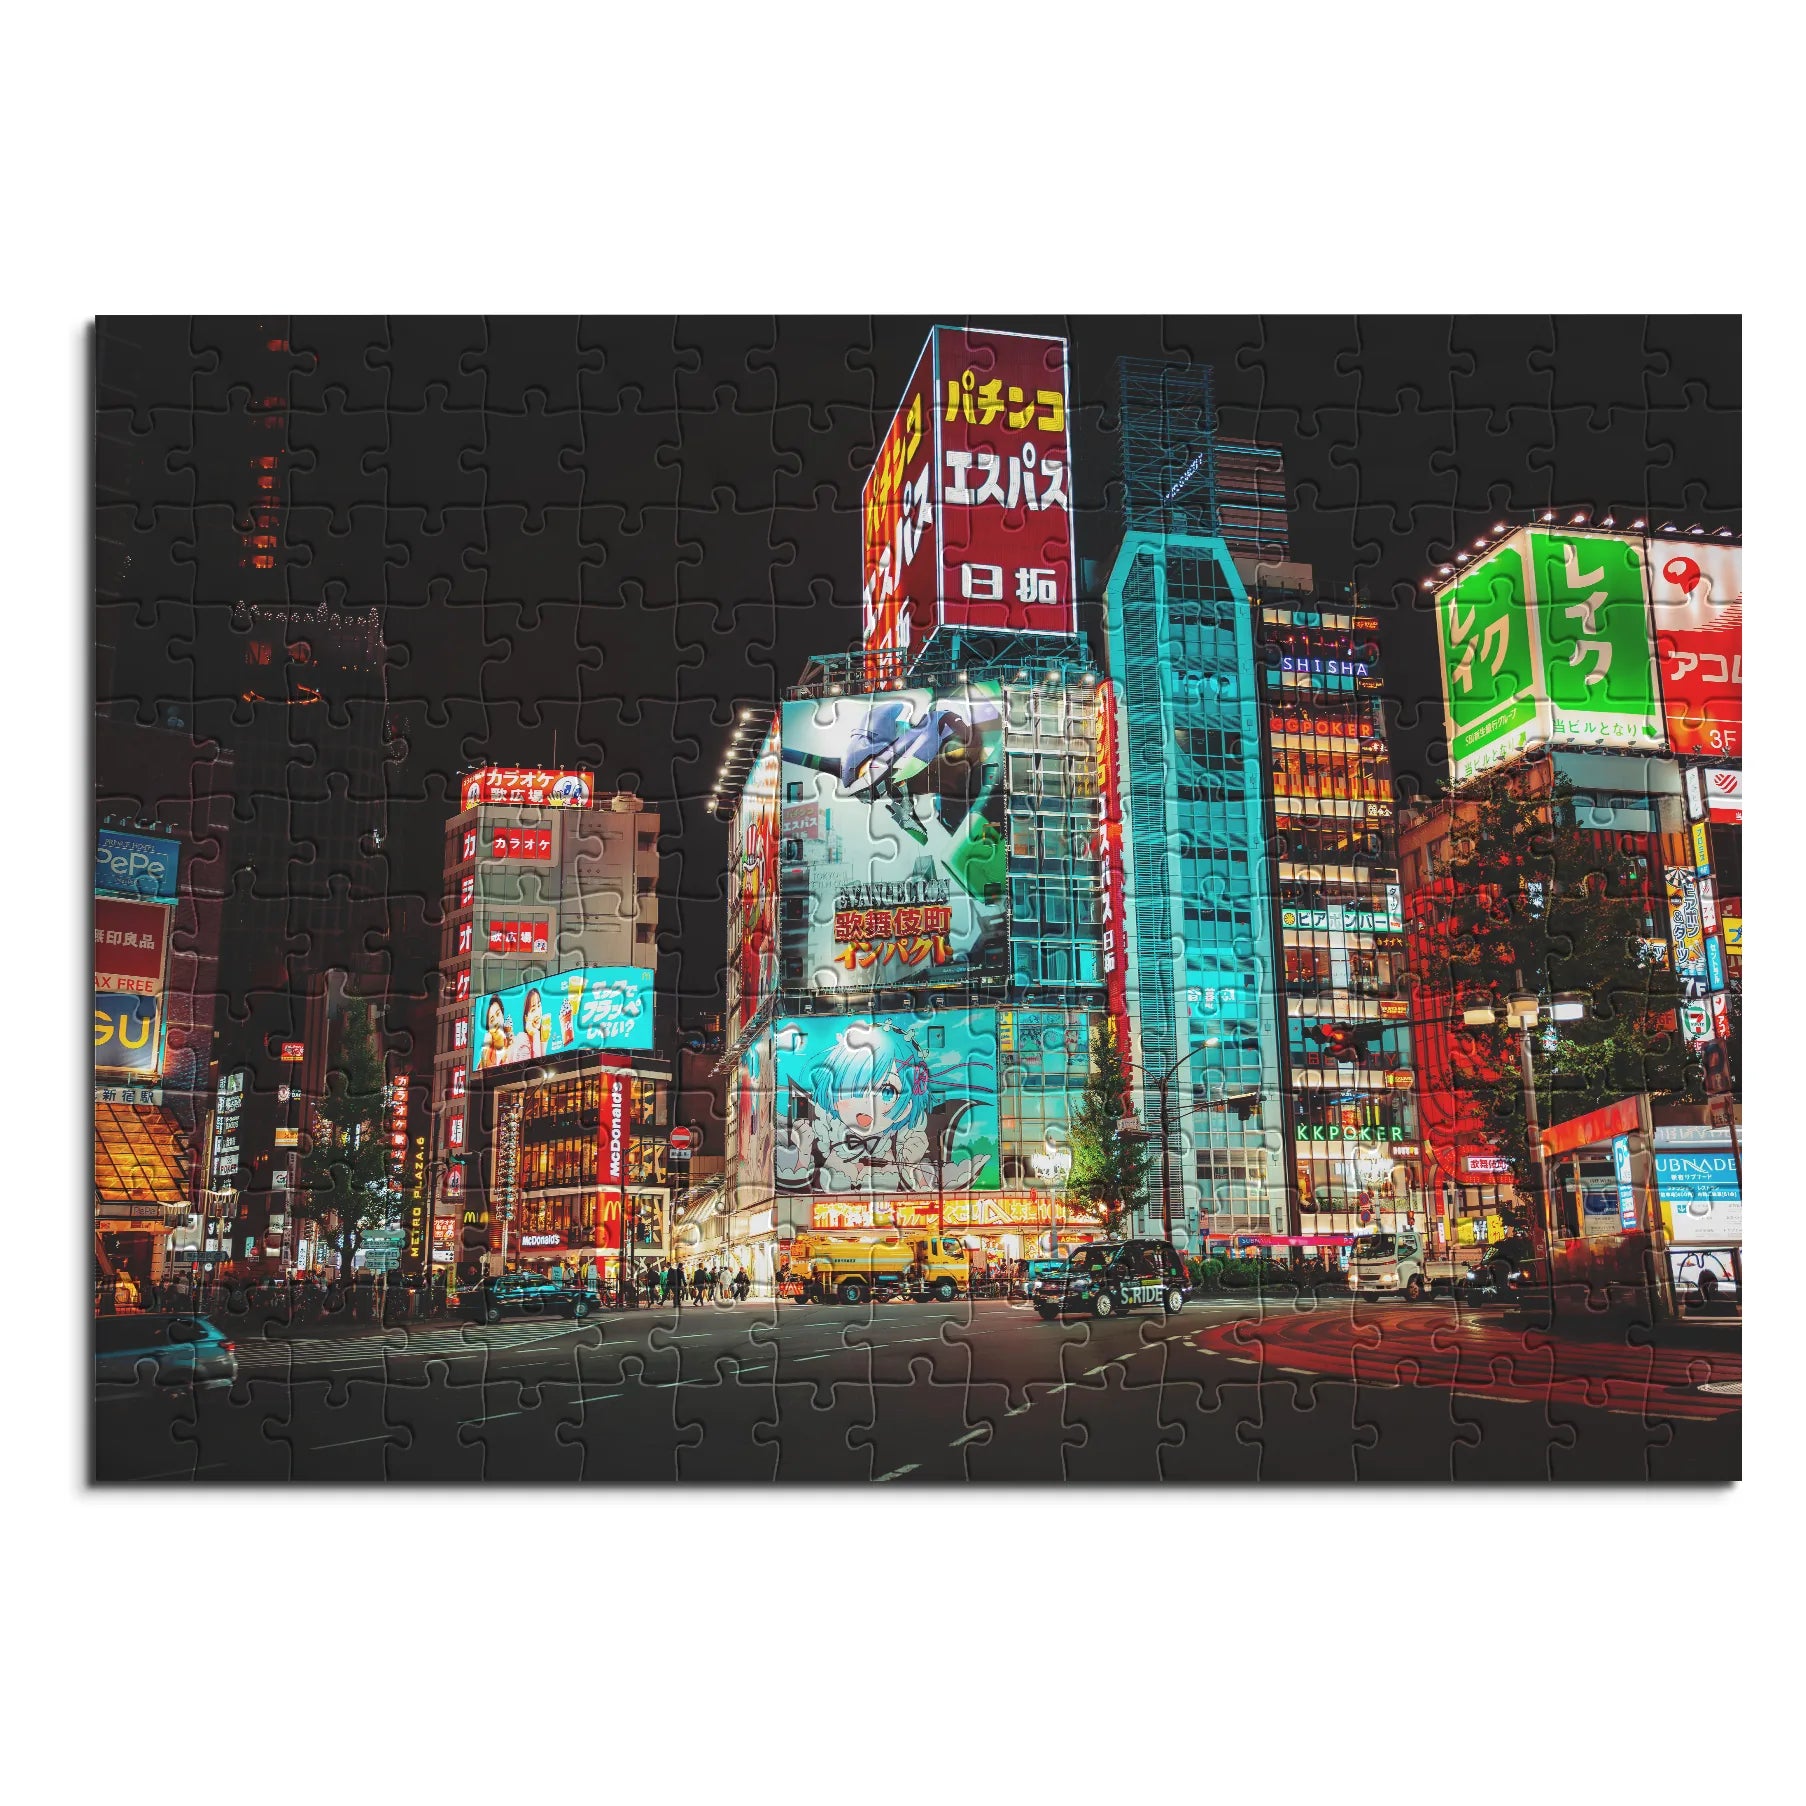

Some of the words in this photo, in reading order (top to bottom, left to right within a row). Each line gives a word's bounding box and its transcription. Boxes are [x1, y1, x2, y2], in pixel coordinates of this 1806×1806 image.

[945, 370, 1065, 432] パチンコ
[866, 392, 922, 552] パチンコ
[944, 442, 1068, 512] エスパス
[1563, 543, 1612, 686] レイク
[1451, 598, 1510, 694] レイク
[1283, 657, 1368, 676] SHISHA
[1553, 719, 1638, 738] 当ビルとなり
[1709, 729, 1737, 749] 3F
[486, 769, 555, 789] カラオケ
[490, 787, 544, 803] 歌広場
[495, 838, 551, 851] カラオケ
[834, 905, 953, 941] 歌舞伎町
[490, 931, 533, 944] 歌広場
[834, 935, 954, 970] インパクト
[117, 978, 154, 993] FREE
[582, 999, 642, 1024] フラッペ
[95, 1008, 150, 1050] GU
[1308, 1052, 1397, 1066] BETY
[102, 1087, 154, 1104] 新宿駅
[609, 1081, 623, 1178] McDonald's
[1297, 1125, 1403, 1141] KKPOKER
[411, 1207, 424, 1258] METRO
[522, 1234, 561, 1246] McDonald's
